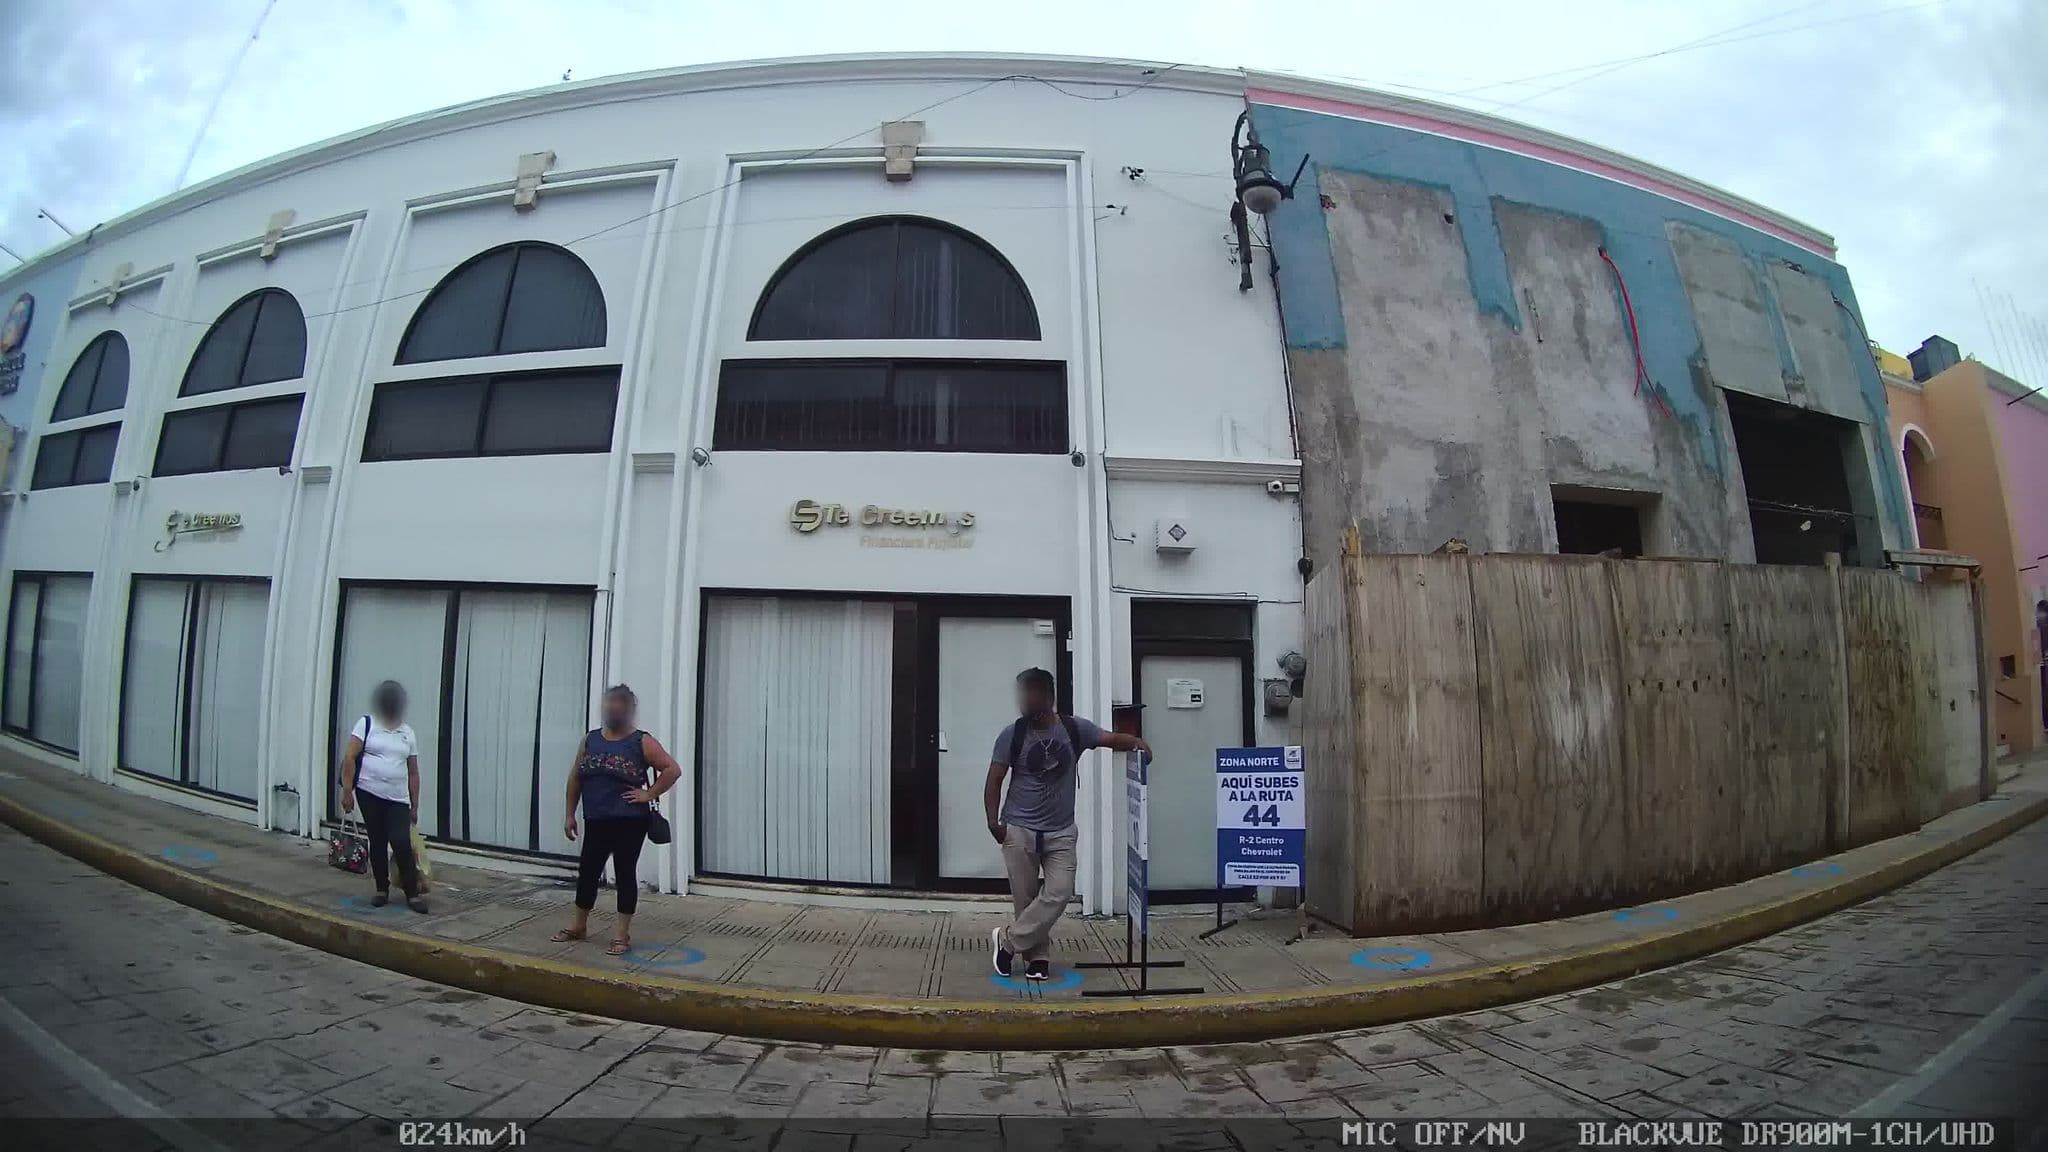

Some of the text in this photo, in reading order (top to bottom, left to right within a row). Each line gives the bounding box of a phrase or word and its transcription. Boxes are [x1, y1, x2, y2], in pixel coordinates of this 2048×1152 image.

[1220, 757, 1246, 767] ZONA
[1247, 757, 1280, 767] NORTE
[1221, 775, 1299, 789] AQUÍ SUBES
[1229, 790, 1294, 802] A LA RUTA
[1243, 804, 1281, 827] 44
[1239, 836, 1285, 845] R-2 Centro
[1241, 847, 1282, 856] Chevrolet
